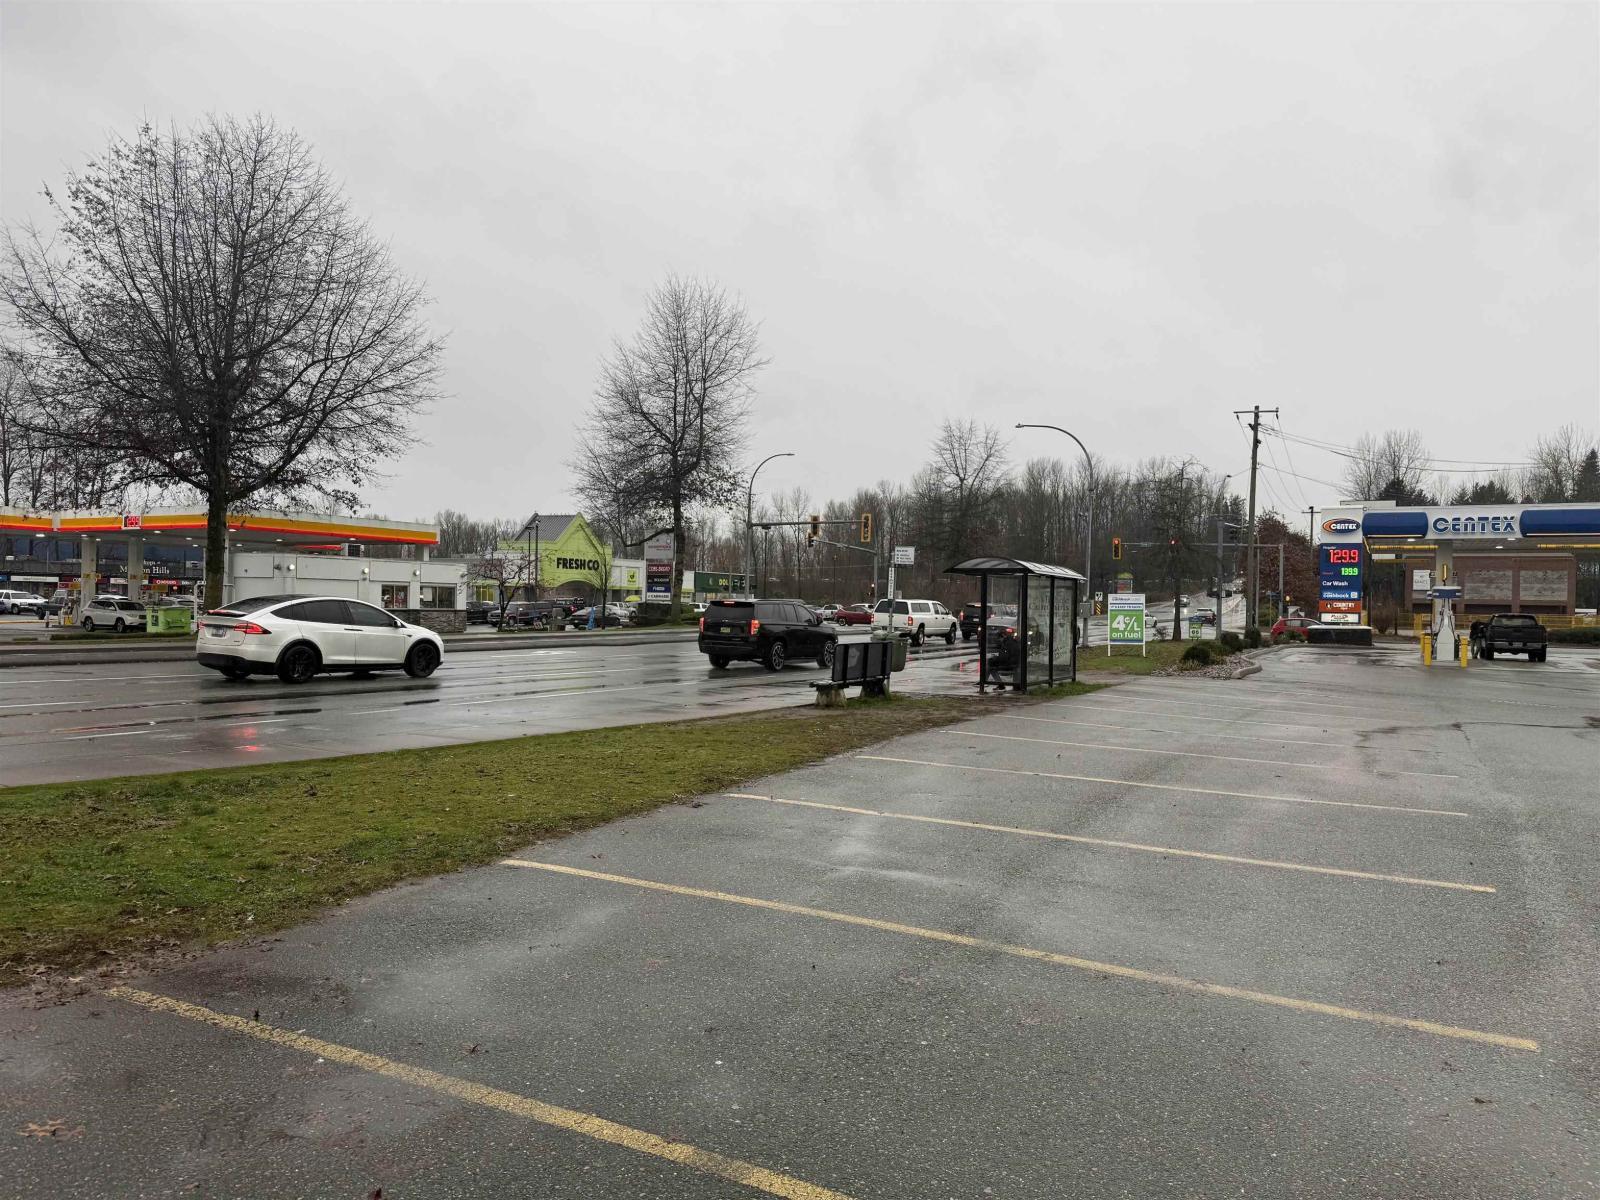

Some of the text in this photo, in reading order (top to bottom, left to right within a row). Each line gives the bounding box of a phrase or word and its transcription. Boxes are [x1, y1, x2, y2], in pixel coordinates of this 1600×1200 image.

[1330, 549, 1359, 563] 129.9
[1341, 567, 1359, 576] 139.9
[1125, 631, 1141, 639] fuel
